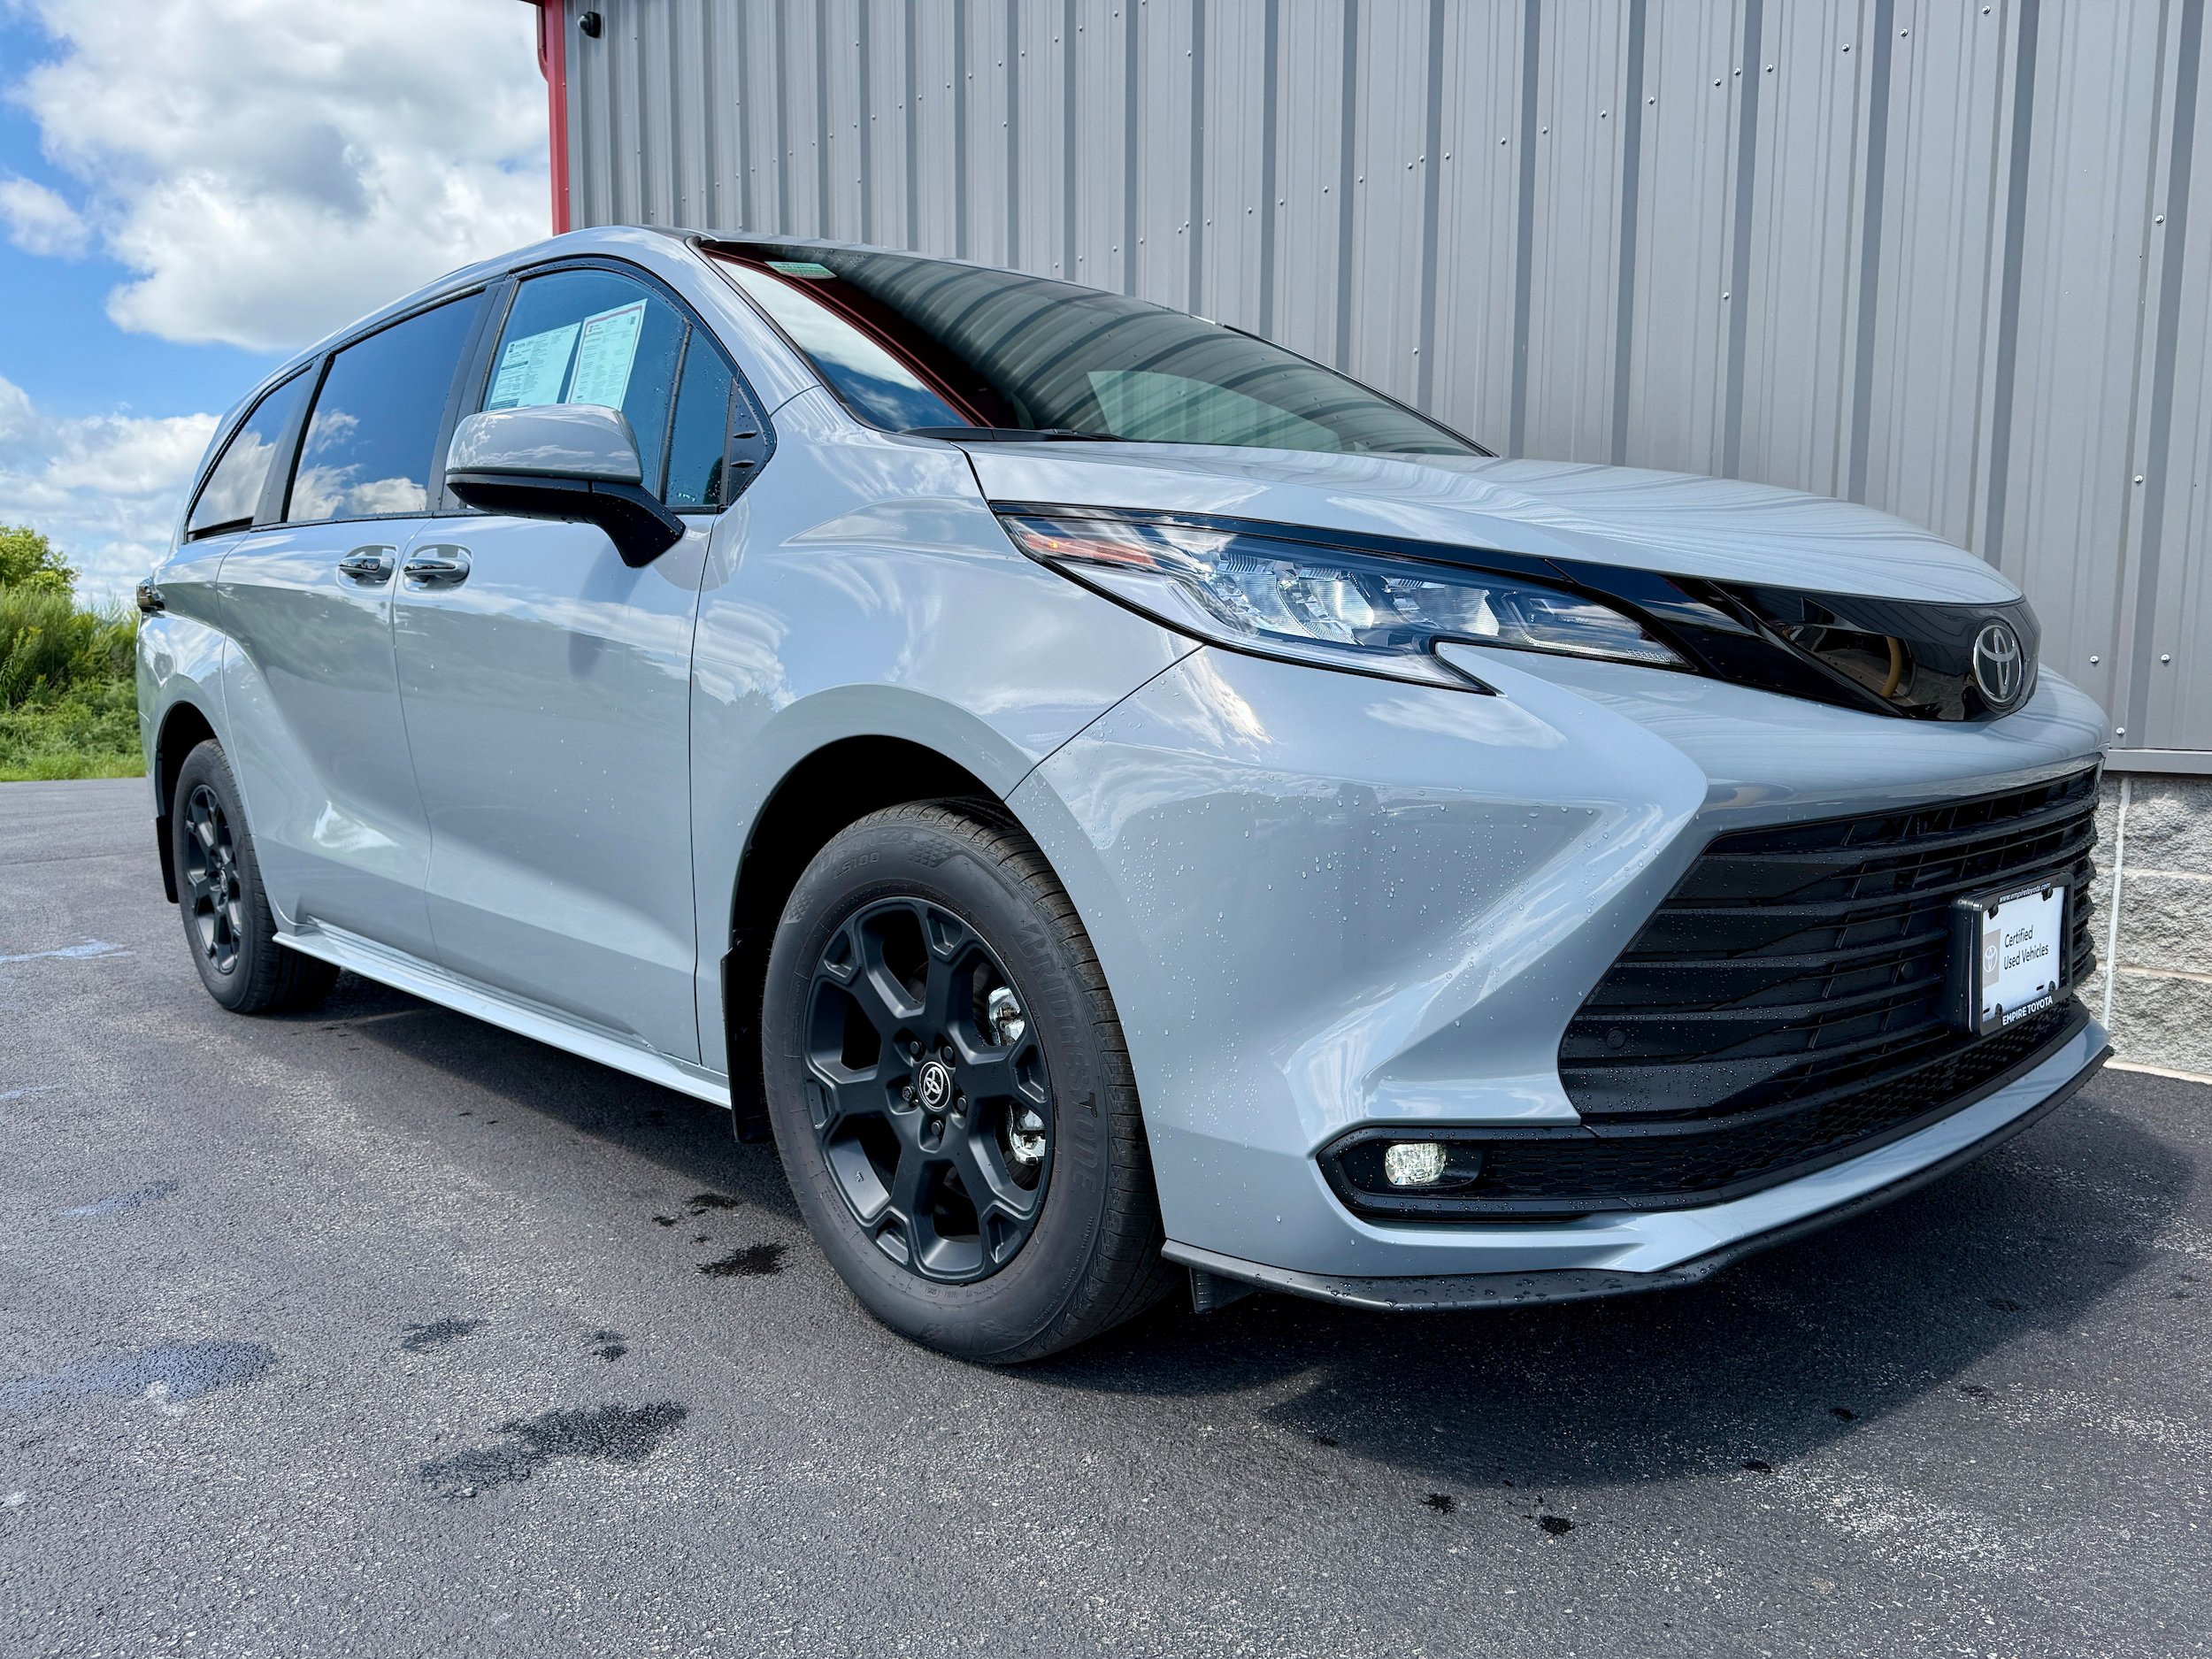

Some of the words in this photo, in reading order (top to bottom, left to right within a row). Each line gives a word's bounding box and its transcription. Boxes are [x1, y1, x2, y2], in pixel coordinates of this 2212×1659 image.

[2004, 925, 2033, 948] Certified
[2004, 950, 2021, 970] Used
[2022, 943, 2049, 963] Vehicles
[2002, 1006, 2027, 1026] EMPIRE
[2027, 995, 2053, 1014] TOYOTA
[1011, 924, 1099, 1194] BRIDGESTONE
